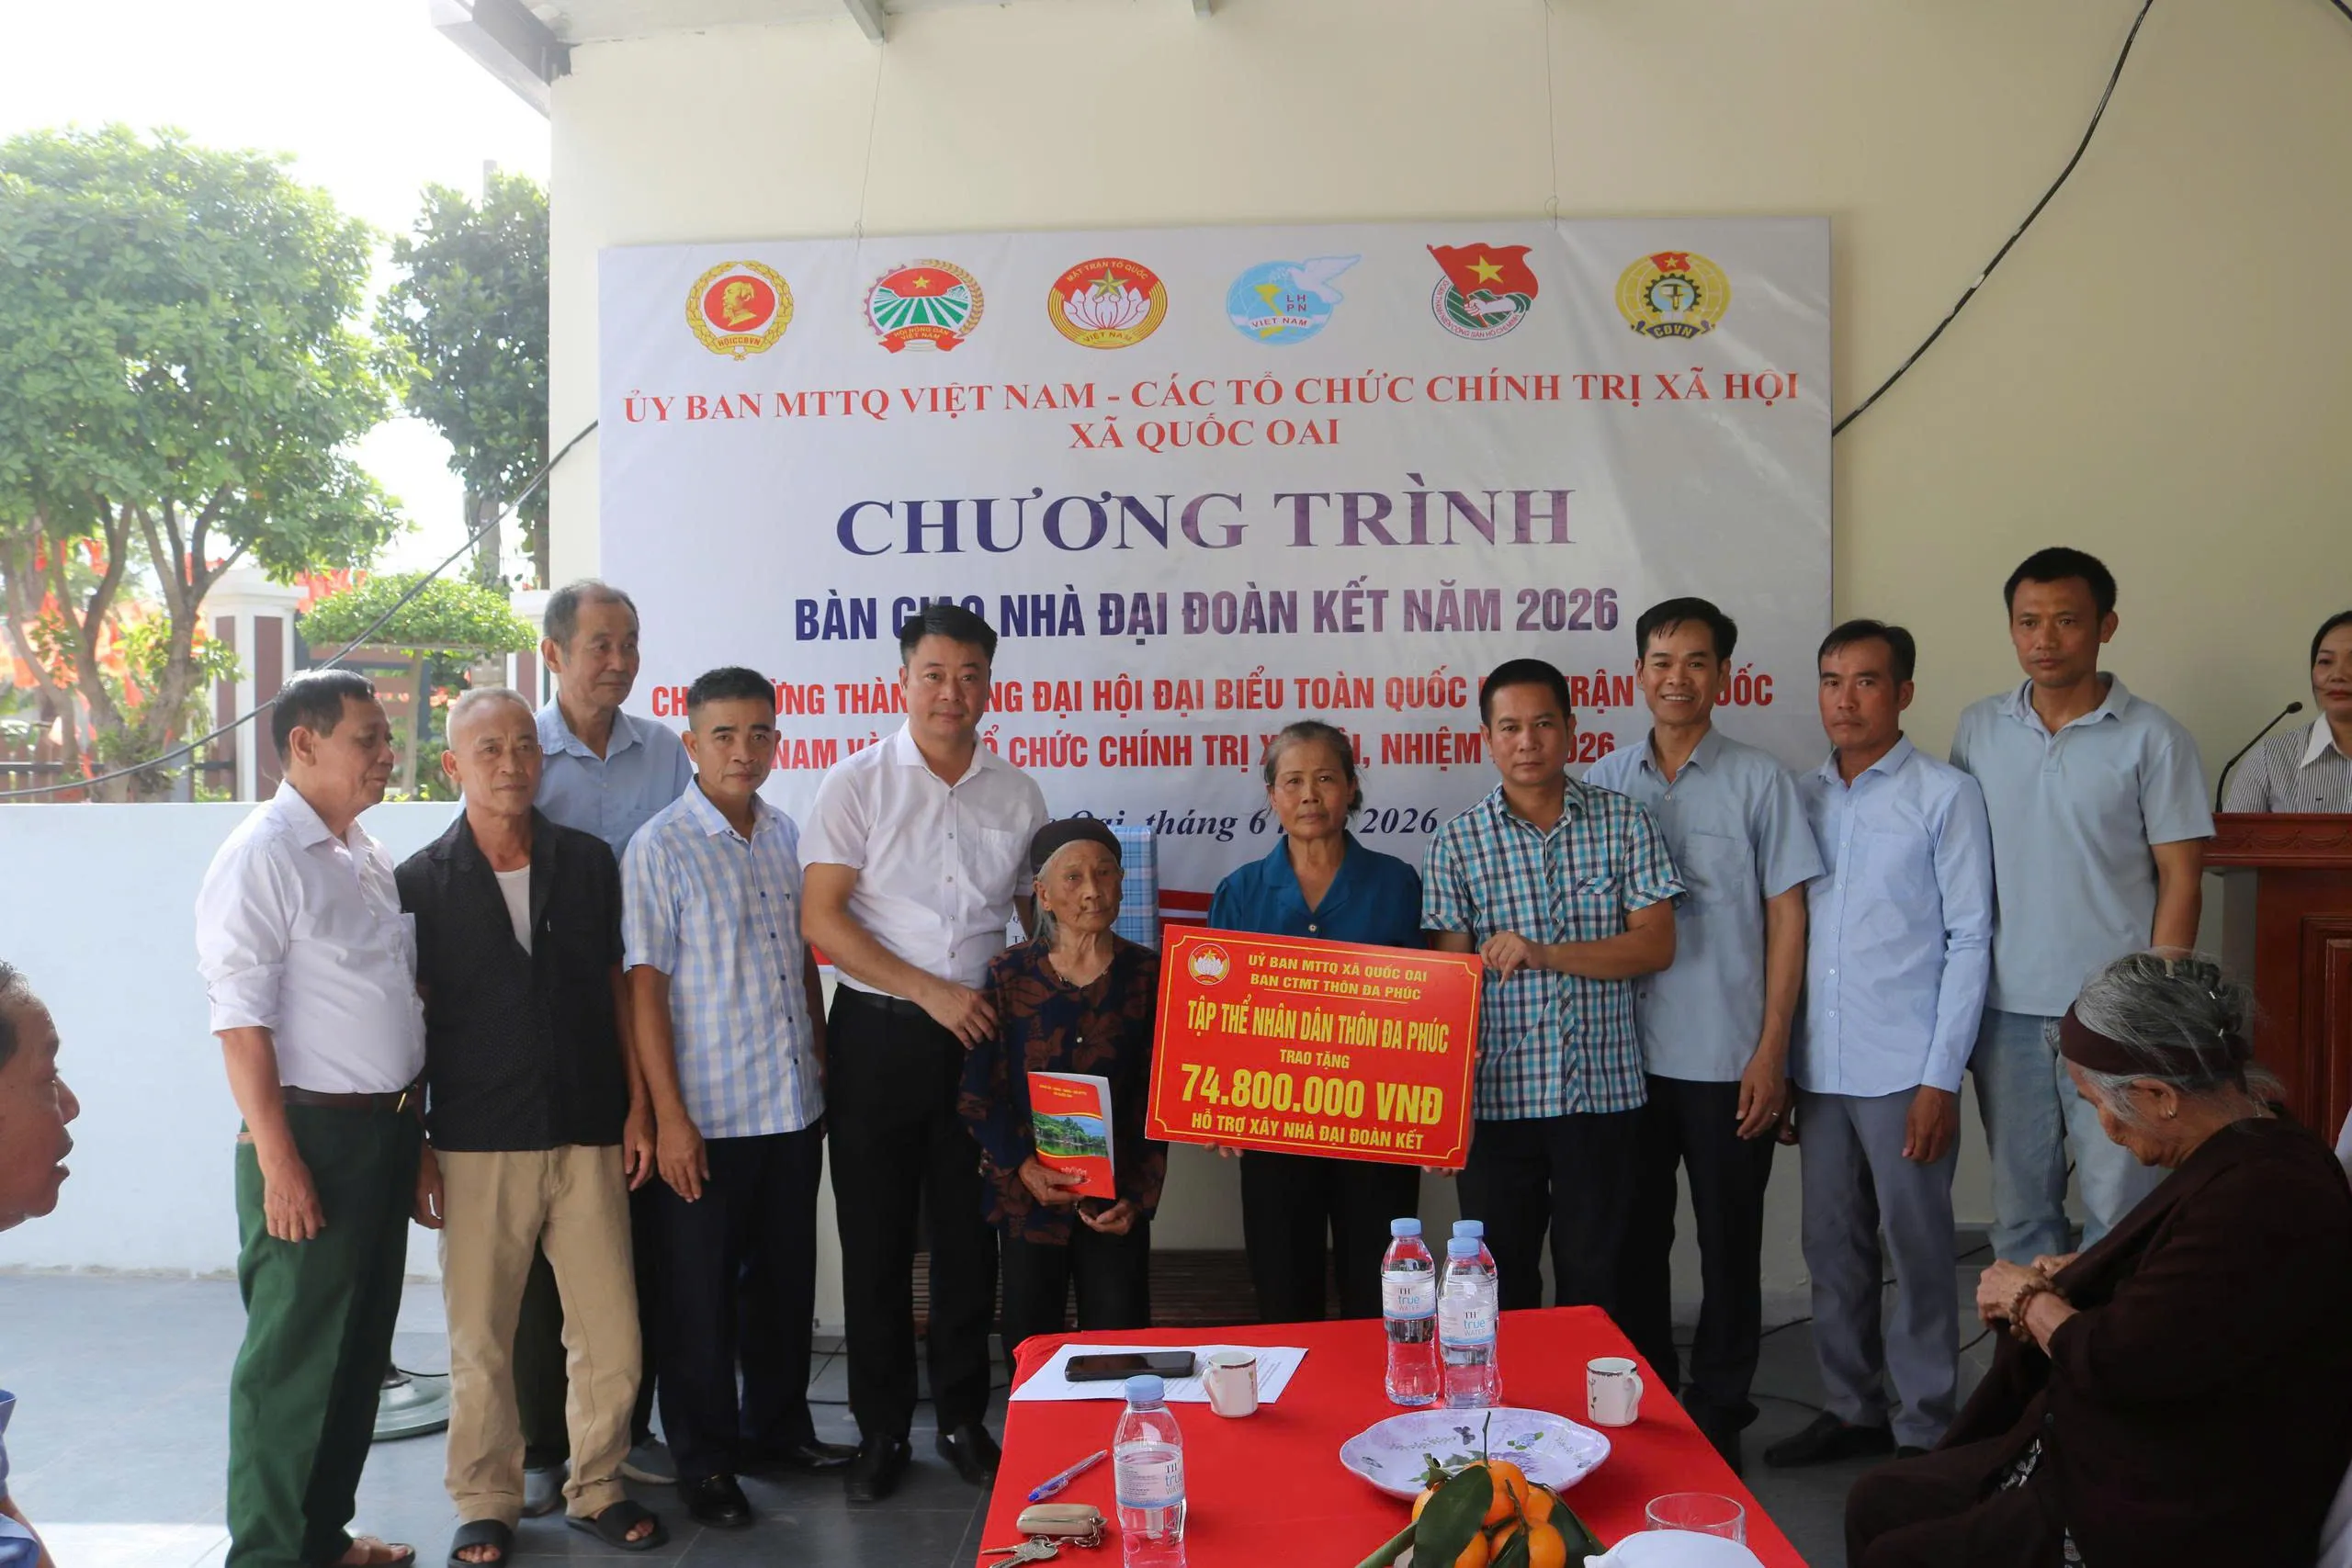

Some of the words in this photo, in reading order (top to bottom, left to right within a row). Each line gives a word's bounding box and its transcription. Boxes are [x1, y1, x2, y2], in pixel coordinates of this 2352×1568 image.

[1283, 317, 1307, 326] NAM
[625, 389, 673, 423] ỦY
[685, 392, 763, 421] BAN
[775, 389, 889, 420] MTTQ
[900, 381, 992, 419] VIỆT
[1005, 382, 1094, 411] NAM
[1131, 374, 1216, 407] CÁC
[1227, 371, 1283, 405] TỔ
[1295, 369, 1414, 404] CHỨC
[1426, 367, 1559, 402] CHÍNH
[1572, 374, 1641, 407] TRỊ
[1654, 367, 1710, 401] XÃ
[1724, 367, 1798, 407] HỘI
[1069, 415, 1123, 449] XÃ
[1136, 412, 1253, 454] QUỐC
[1266, 418, 1340, 446] OAI
[836, 487, 1249, 556] CHƯƠNG
[1274, 473, 1577, 547] TRÌNH
[796, 589, 876, 640] BÀN
[1001, 584, 1086, 637] NHÀ
[1098, 592, 1167, 645] ĐẠI
[1182, 581, 1297, 635] ĐOÀN
[1313, 575, 1390, 634] KẾT
[1405, 579, 1501, 632] NĂM
[1517, 588, 1618, 631] 2026
[651, 686, 689, 717] CH
[774, 678, 825, 716] ỪNG
[834, 677, 908, 714] THÀN
[984, 681, 1023, 713] NG
[1032, 680, 1083, 719] ĐẠI
[1093, 672, 1143, 718] HỘI
[1153, 679, 1205, 718] ĐẠI
[1216, 666, 1284, 710] BIỂU
[1296, 671, 1374, 710] TOÀN
[1385, 665, 1467, 712] QUỐC
[1567, 669, 1634, 714] RẬN
[1714, 663, 1773, 706] UỐC
[771, 739, 837, 770] NAM
[1009, 728, 1088, 768] CHỨC
[1099, 728, 1193, 768] CHÍNH
[1203, 734, 1249, 773] TRỊ
[1381, 726, 1482, 772] NHIỆM
[1147, 809, 1238, 842] tháng
[1250, 808, 1268, 835] 6
[1359, 808, 1440, 834] 2026
[1249, 952, 1267, 966] UỶ
[1270, 957, 1298, 970] BAN
[1302, 959, 1339, 975] MTTQ
[1364, 963, 1401, 980] QUỐC
[1405, 969, 1428, 983] OAI
[1250, 973, 1280, 987] BAN
[1283, 976, 1319, 990] CTMT
[1323, 979, 1359, 995] THÔN
[1362, 984, 1381, 998] ĐA
[1385, 985, 1421, 1000] PHÚC
[1187, 995, 1216, 1039] TẬP
[1221, 994, 1251, 1035] THỂ
[1252, 1002, 1296, 1039] NHÂN
[1300, 1006, 1332, 1043] DÂN
[1338, 1010, 1377, 1048] THÔN
[1382, 1019, 1404, 1051] ĐA
[1407, 1016, 1449, 1055] PHÚC
[1280, 1048, 1313, 1066] TRAO
[1316, 1050, 1351, 1069] TẶNG
[1181, 1063, 1365, 1119] 74.800.000
[1376, 1081, 1443, 1126] VNĐ
[1191, 1108, 1212, 1130] HỖ
[1217, 1114, 1245, 1137] TRỢ
[1250, 1117, 1279, 1136] XÂY
[1318, 1125, 1345, 1146] ĐẠI
[1349, 1127, 1392, 1148] ĐOÀN
[1396, 1128, 1424, 1150] KẾT
[1398, 1295, 1419, 1305] true
[1464, 1319, 1486, 1329] true
